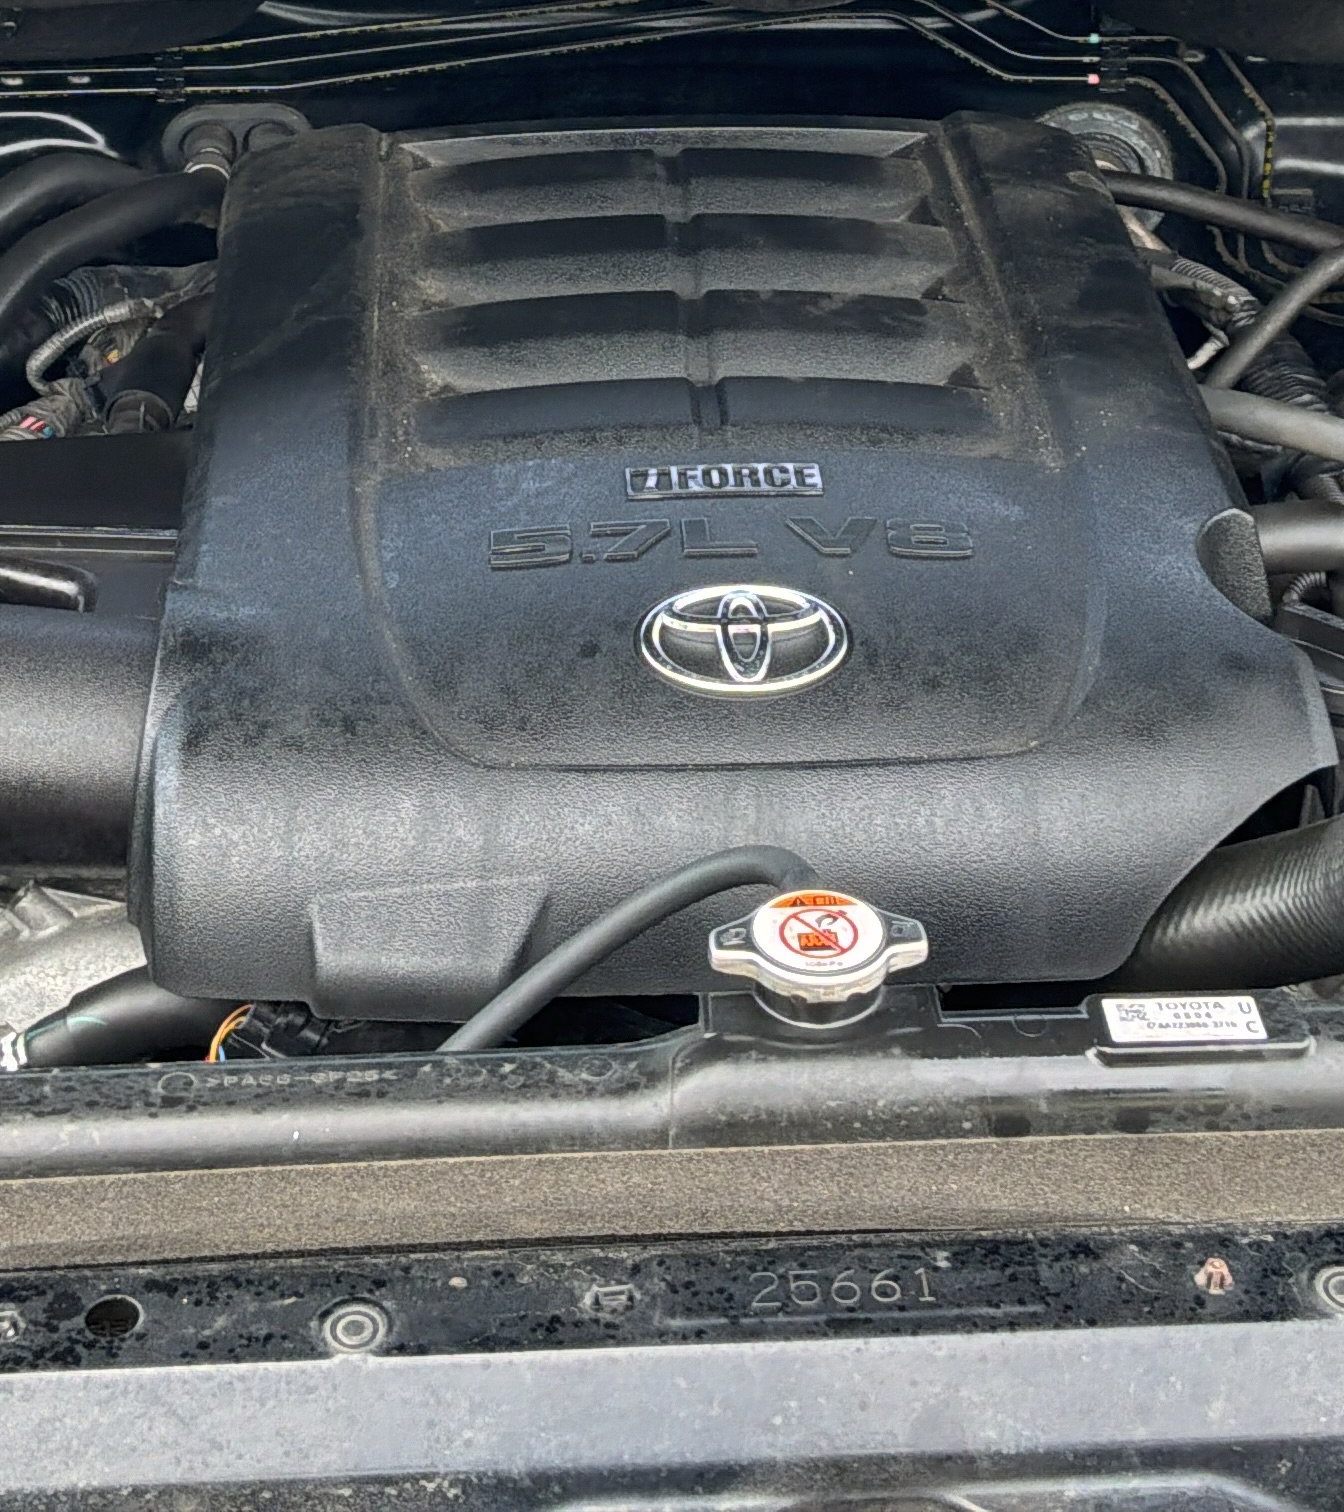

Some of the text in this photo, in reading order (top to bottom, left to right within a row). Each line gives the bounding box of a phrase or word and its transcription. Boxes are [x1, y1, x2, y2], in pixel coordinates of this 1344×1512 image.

[489, 515, 975, 569] 5.7L V8
[1154, 1000, 1226, 1012] TOYOTA
[1245, 1020, 1260, 1034] C
[748, 1267, 937, 1306] 25661
